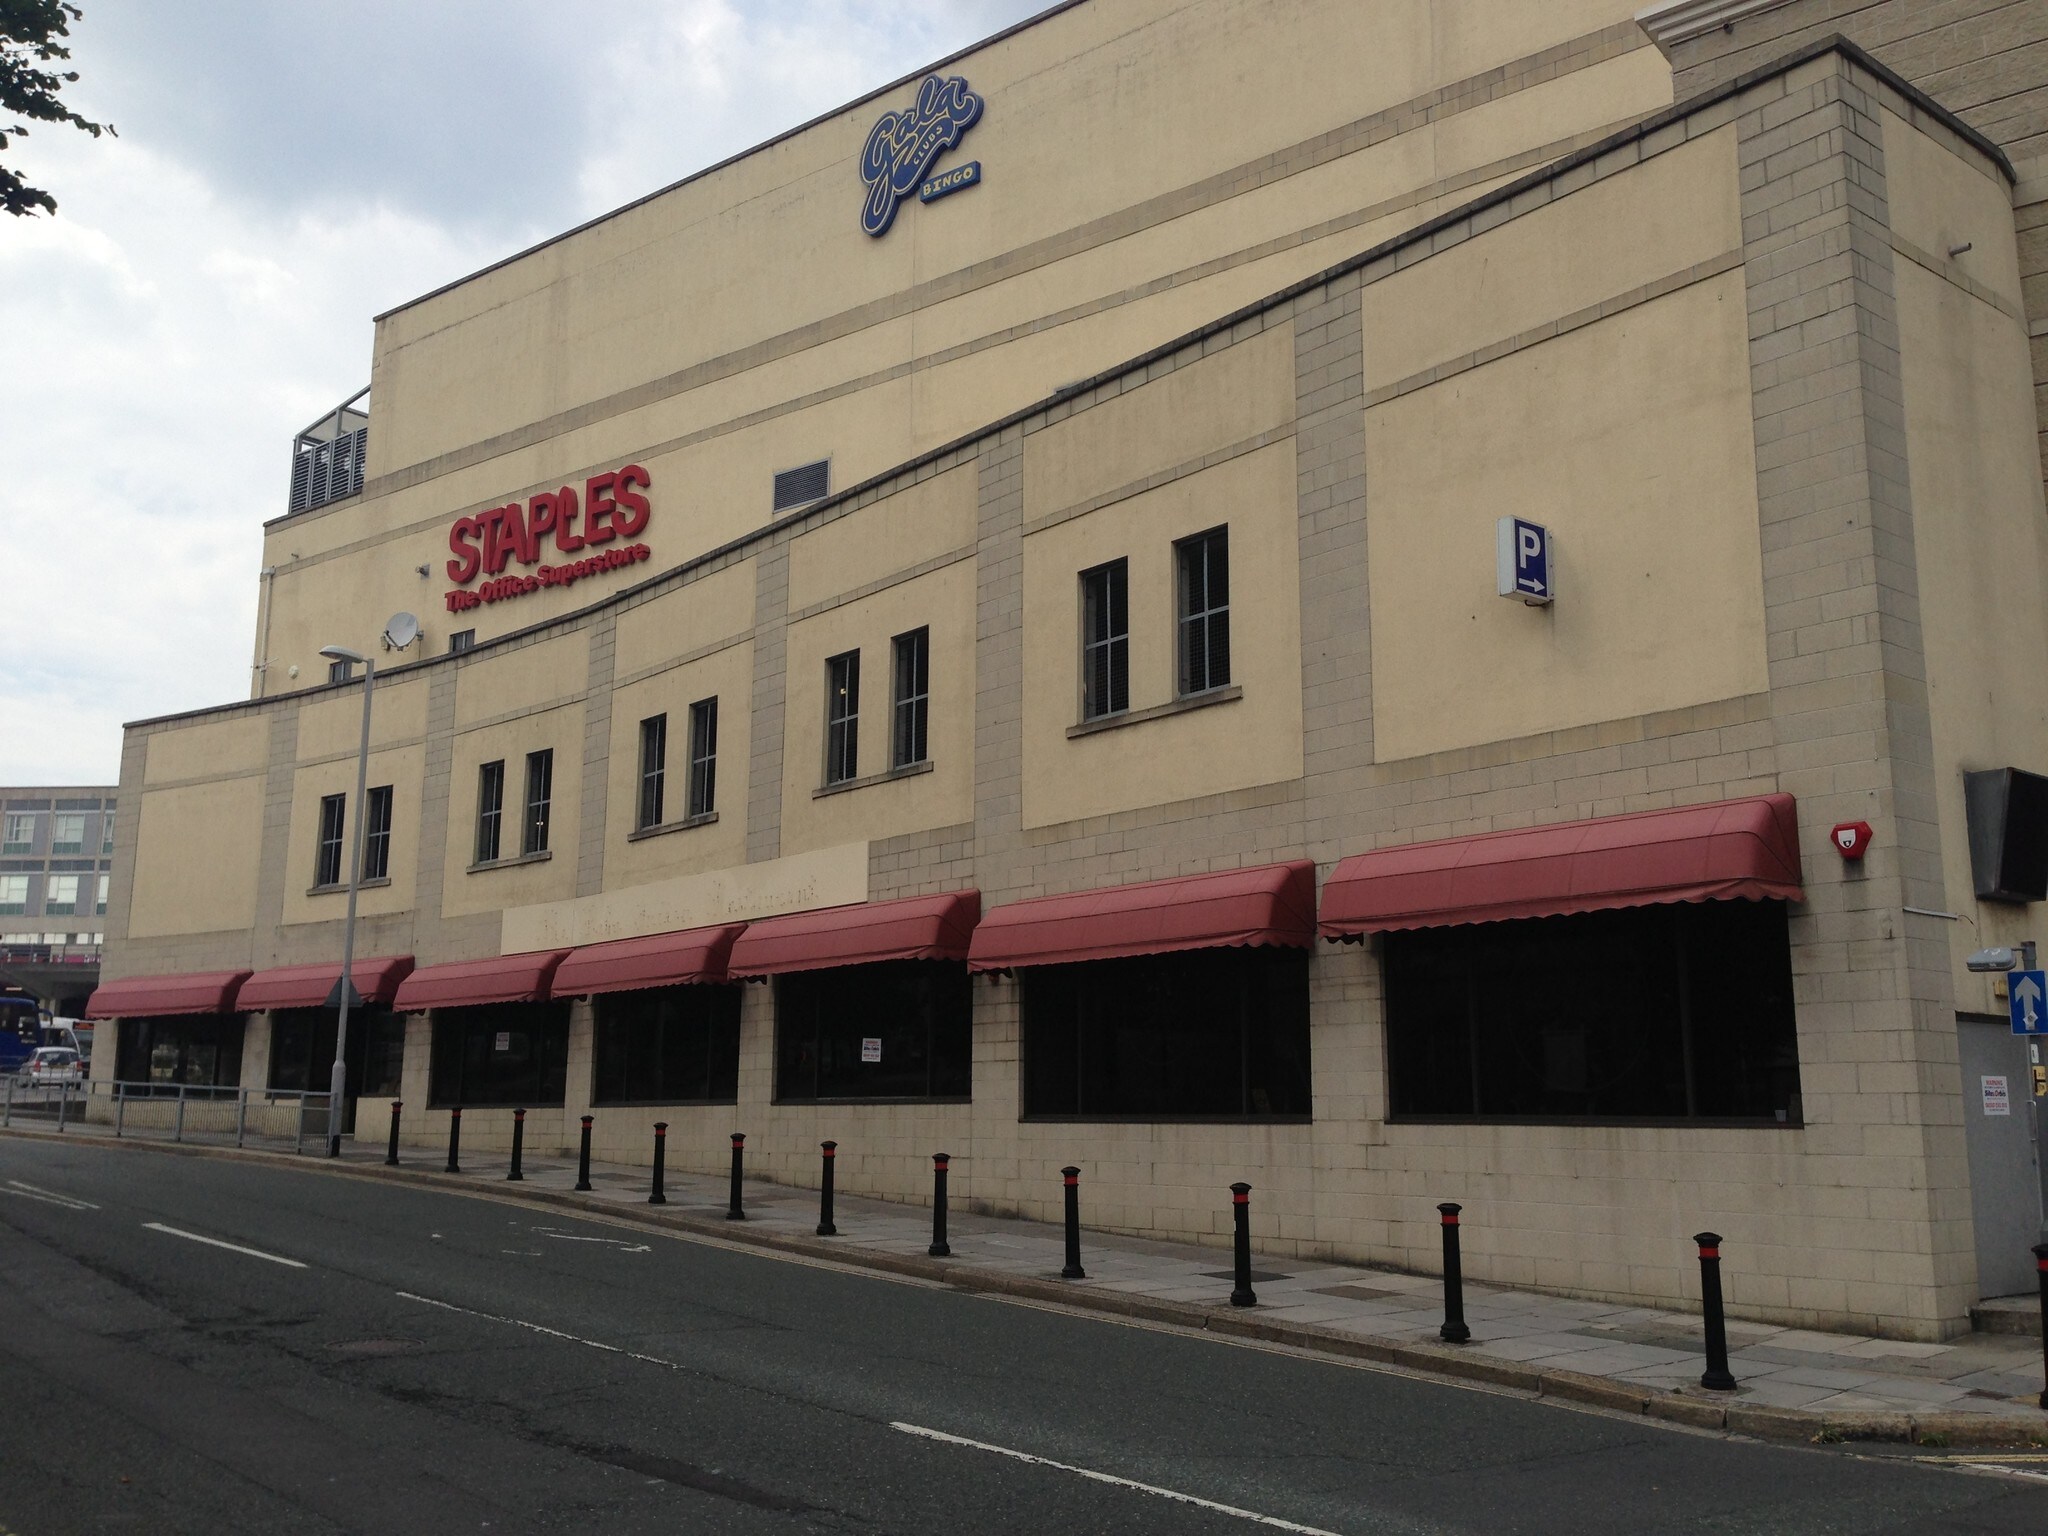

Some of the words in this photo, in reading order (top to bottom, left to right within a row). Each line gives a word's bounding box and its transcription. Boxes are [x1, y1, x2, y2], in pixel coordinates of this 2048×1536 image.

[861, 77, 977, 233] Gala
[913, 126, 943, 165] CLUBS
[923, 167, 973, 196] BINGO
[447, 464, 650, 583] STAPLES
[1519, 526, 1540, 568] P
[445, 589, 480, 612] The
[479, 575, 539, 603] Office
[537, 543, 650, 587] Superstore
